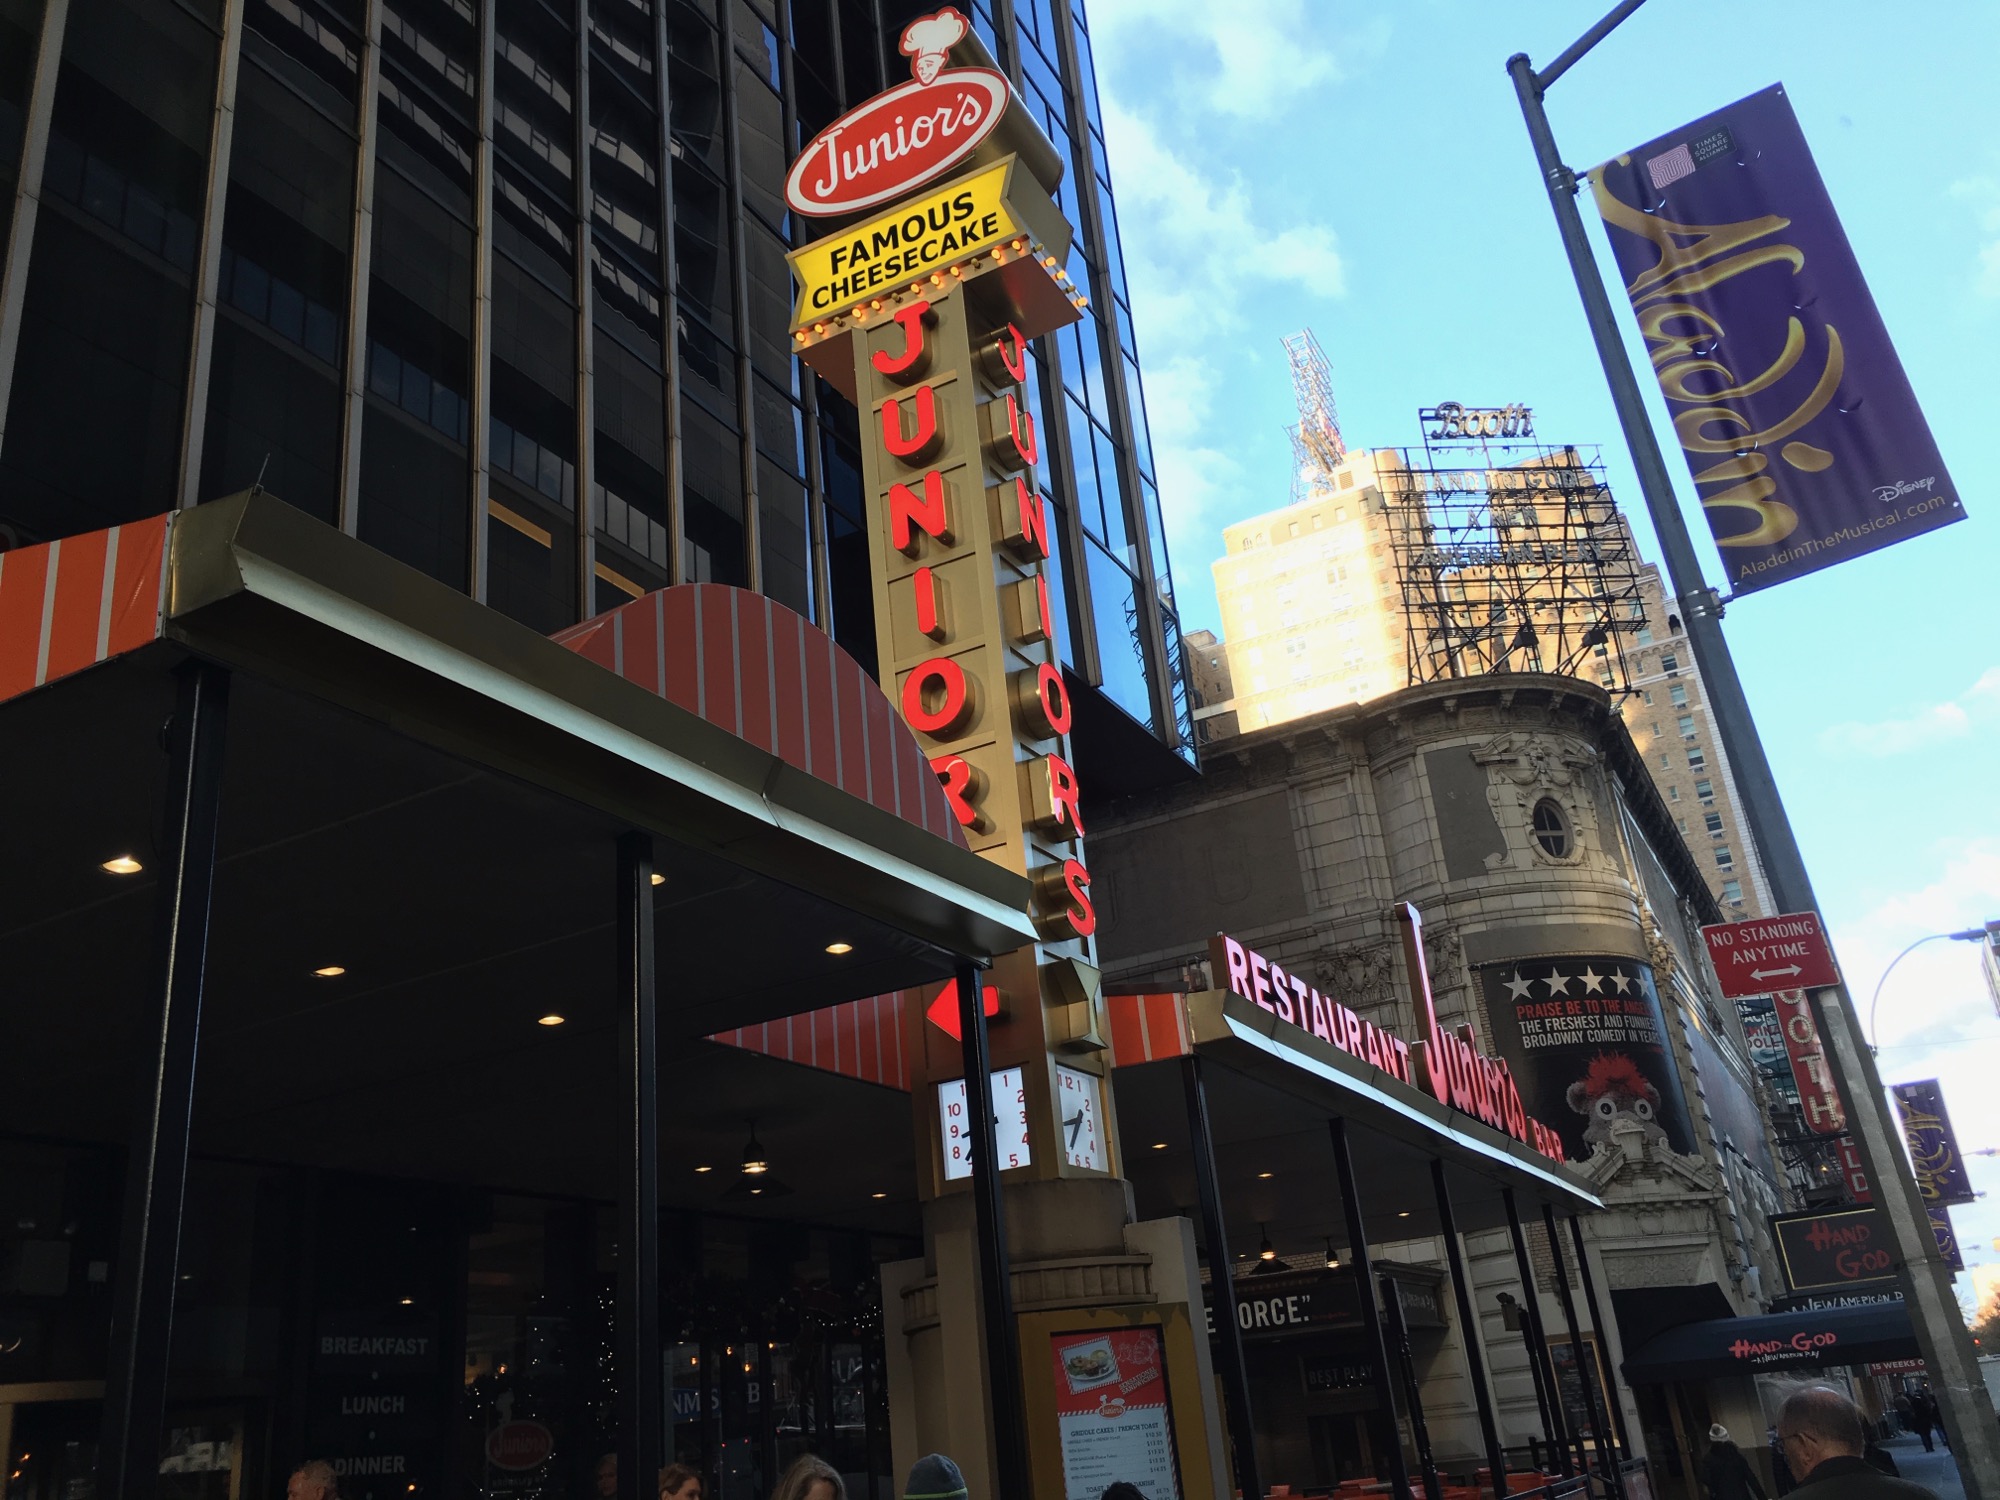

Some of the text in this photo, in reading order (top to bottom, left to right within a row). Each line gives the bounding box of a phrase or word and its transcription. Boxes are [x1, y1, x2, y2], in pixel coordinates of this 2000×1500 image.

[815, 93, 982, 197] Junior's
[1694, 137, 1729, 158] SQUARE
[1695, 132, 1723, 149] TIMES
[1699, 144, 1728, 161] ALLIANCE
[830, 192, 975, 276] FAMOUS
[812, 213, 999, 309] CHEESECAKE
[1431, 401, 1531, 439] Booth
[1413, 469, 1577, 491] HAND TO GOD
[1740, 495, 1946, 578] AladdinTheMusical.com
[1421, 541, 1603, 565] AMERICAN PLAY
[1711, 921, 1814, 947] NO STANDING
[1733, 942, 1810, 965] ANYTIME
[1225, 936, 1409, 1085] RESTAURANT
[1516, 1001, 1563, 1020] PRAISE
[1565, 1001, 1581, 1015] BE
[1584, 1000, 1600, 1014] TO
[1601, 1000, 1621, 1013] THE
[1519, 1015, 1657, 1035] THE FRESHEST AND FUNNIEST
[1522, 1033, 1585, 1049] BROADWAY
[1587, 1029, 1626, 1043] COMEDY
[1628, 1030, 1638, 1042] IN
[1003, 1075, 1008, 1087] 1
[1065, 1076, 1073, 1090] 12
[1077, 1080, 1081, 1093] 1
[1017, 1089, 1025, 1103] 2
[1085, 1099, 1090, 1112] 2
[947, 1103, 961, 1117] 10
[1020, 1110, 1027, 1125] 3
[950, 1125, 958, 1139] 9
[1087, 1120, 1092, 1133] 3
[1021, 1132, 1029, 1146] 4
[1089, 1140, 1095, 1154] 4
[1532, 1117, 1566, 1165] BAR
[952, 1146, 961, 1160] 8
[1009, 1153, 1019, 1168] 5
[1075, 1154, 1080, 1167] 6
[1085, 1157, 1090, 1169] 5
[1805, 1220, 1871, 1252] HAND
[1836, 1249, 1890, 1278] GOD
[1840, 1294, 1890, 1307] AMERICAN
[320, 1336, 428, 1355] BREAKFAST
[1728, 1338, 1782, 1359] HAND
[1791, 1332, 1836, 1351] GOD
[1762, 1353, 1778, 1363] NEW
[1883, 1360, 1915, 1369] WEEKS
[1309, 1363, 1373, 1384] BEST PLAY
[342, 1395, 405, 1415] LUNCH
[1071, 1429, 1095, 1437] GRIDDLE
[1140, 1422, 1158, 1430] TOAST
[335, 1455, 405, 1476] DINNER
